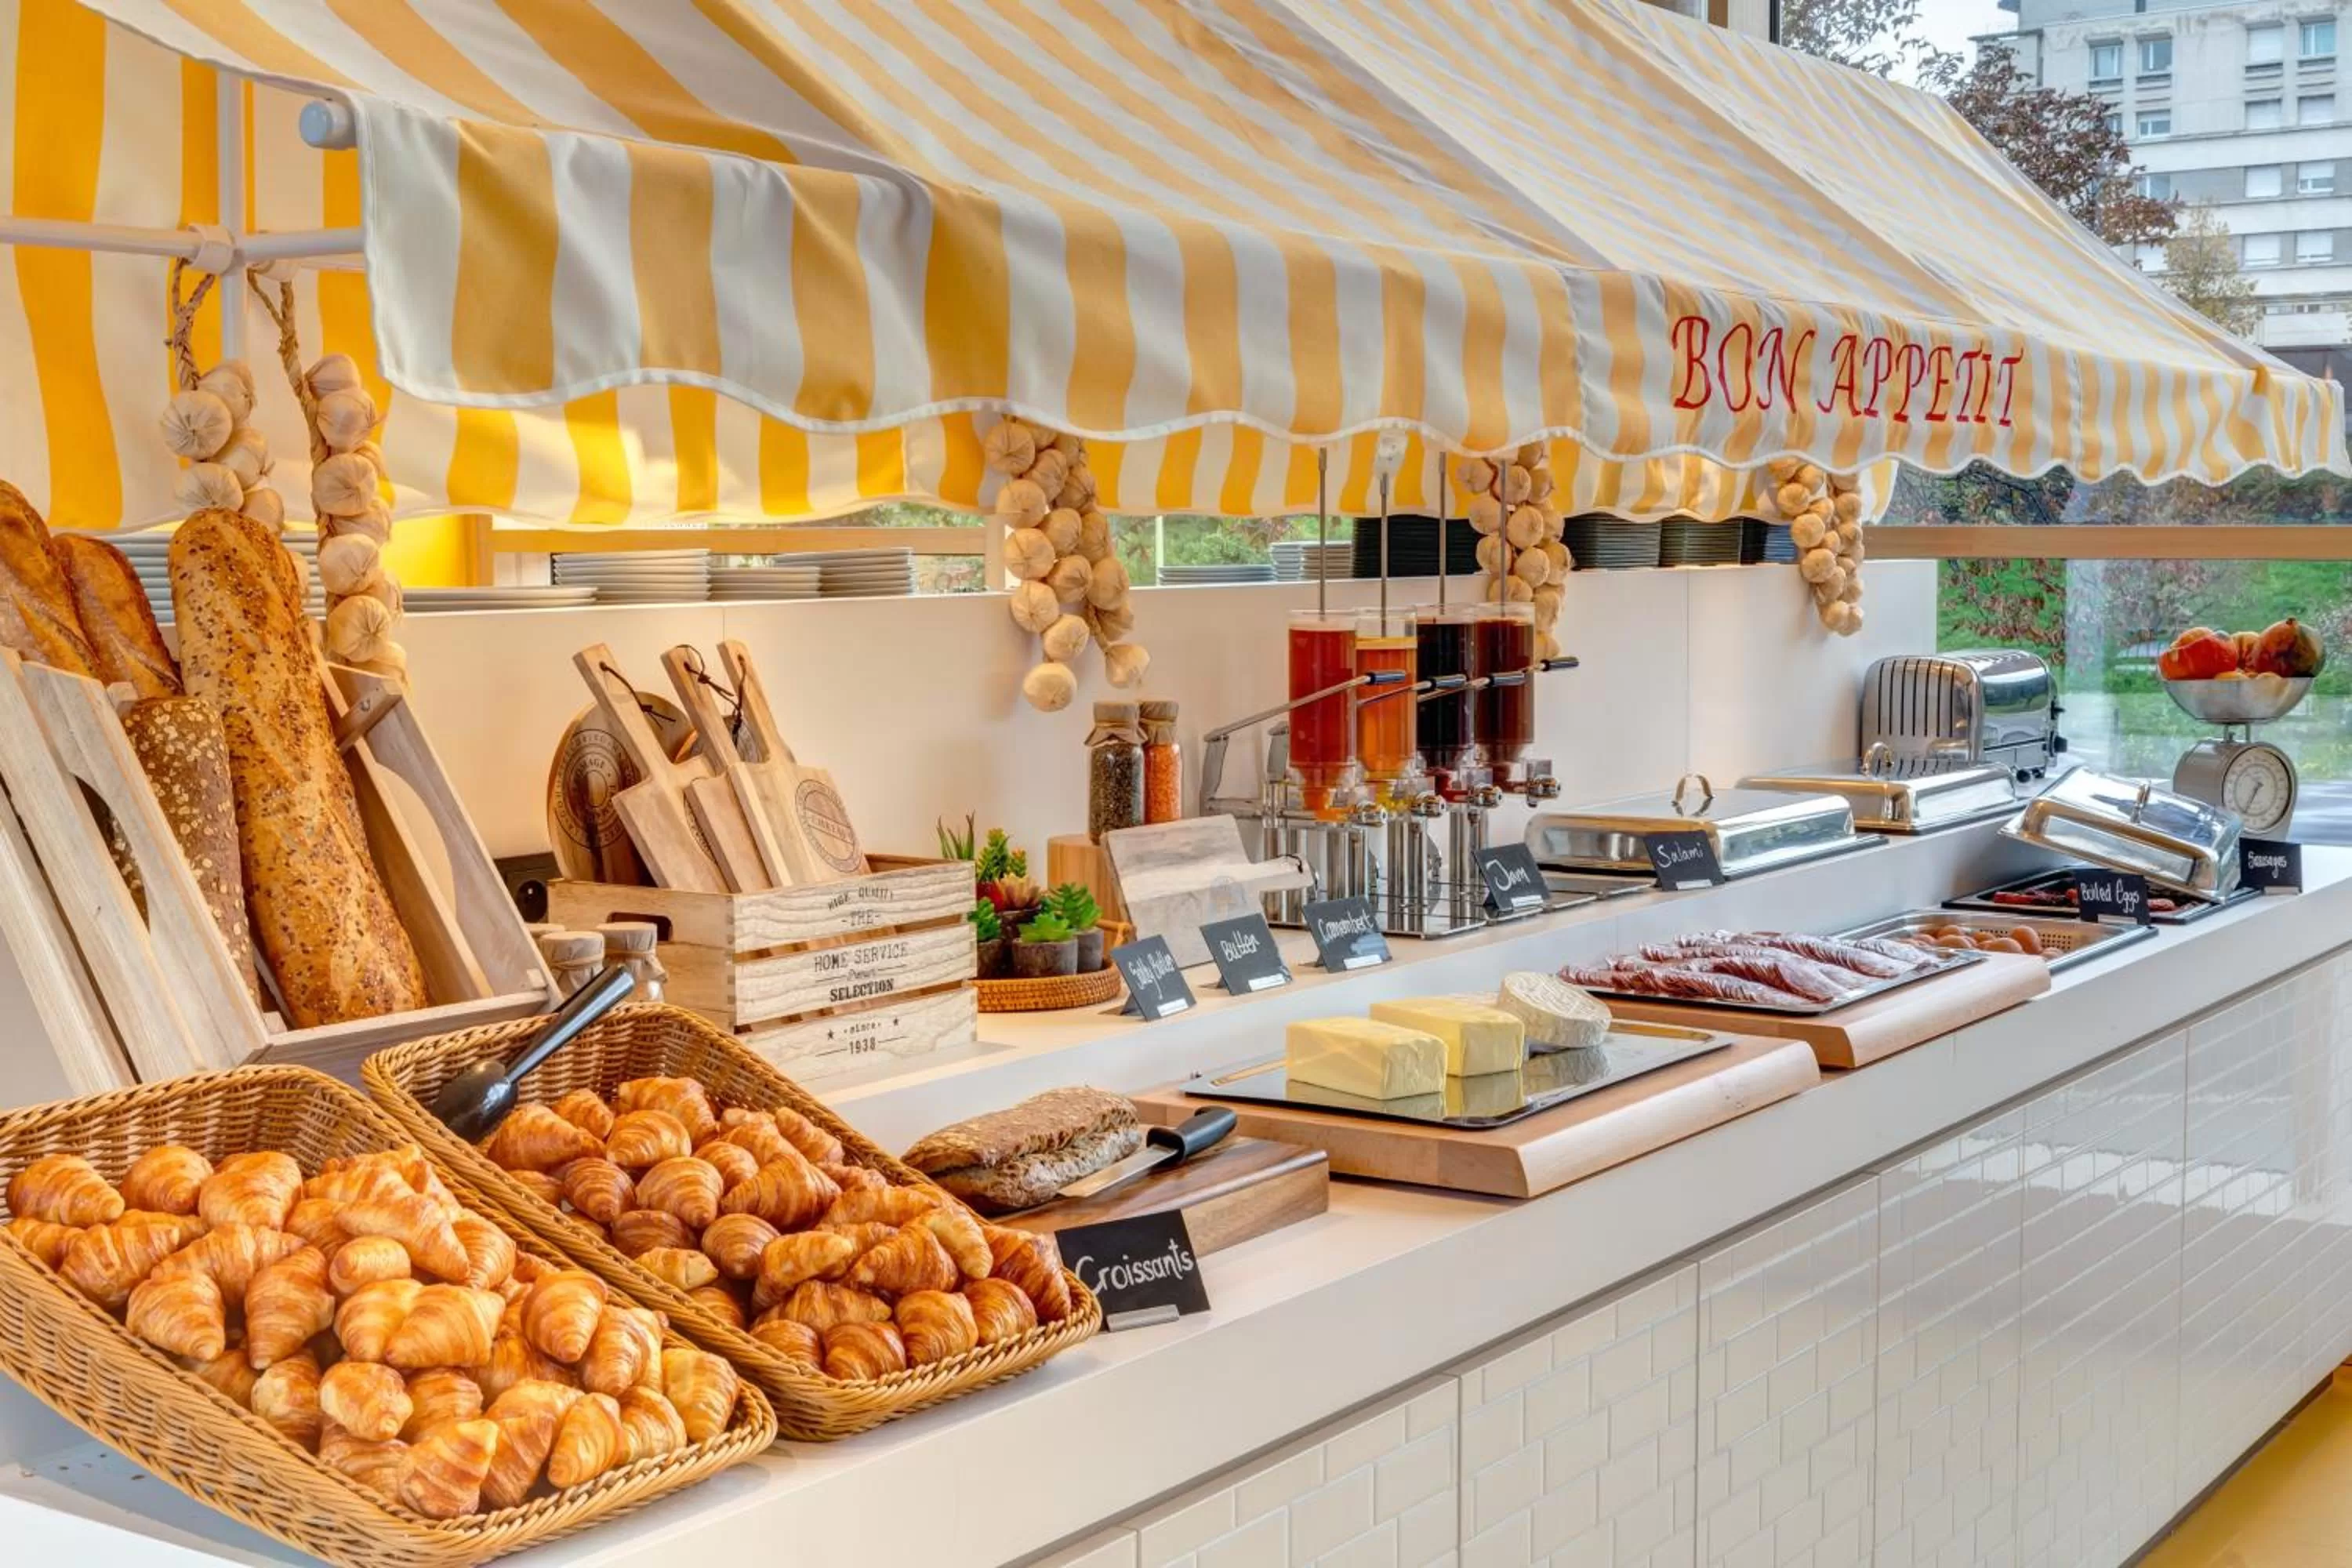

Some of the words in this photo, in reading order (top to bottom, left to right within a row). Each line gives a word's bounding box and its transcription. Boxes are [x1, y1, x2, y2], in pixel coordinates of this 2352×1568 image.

[1671, 315, 1816, 414] BON
[1817, 334, 2024, 426] APPETIT
[1656, 840, 1704, 869] Salami
[1486, 858, 1531, 891] Jam
[2080, 881, 2112, 902] Boiled
[2116, 878, 2140, 913] Eggs
[814, 951, 848, 972] HOME
[854, 942, 909, 964] SERVICE
[1220, 931, 1261, 963] Butter
[829, 978, 894, 1002] SELECTION
[849, 1036, 876, 1054] 1938
[1075, 1238, 1194, 1294] Croissants
